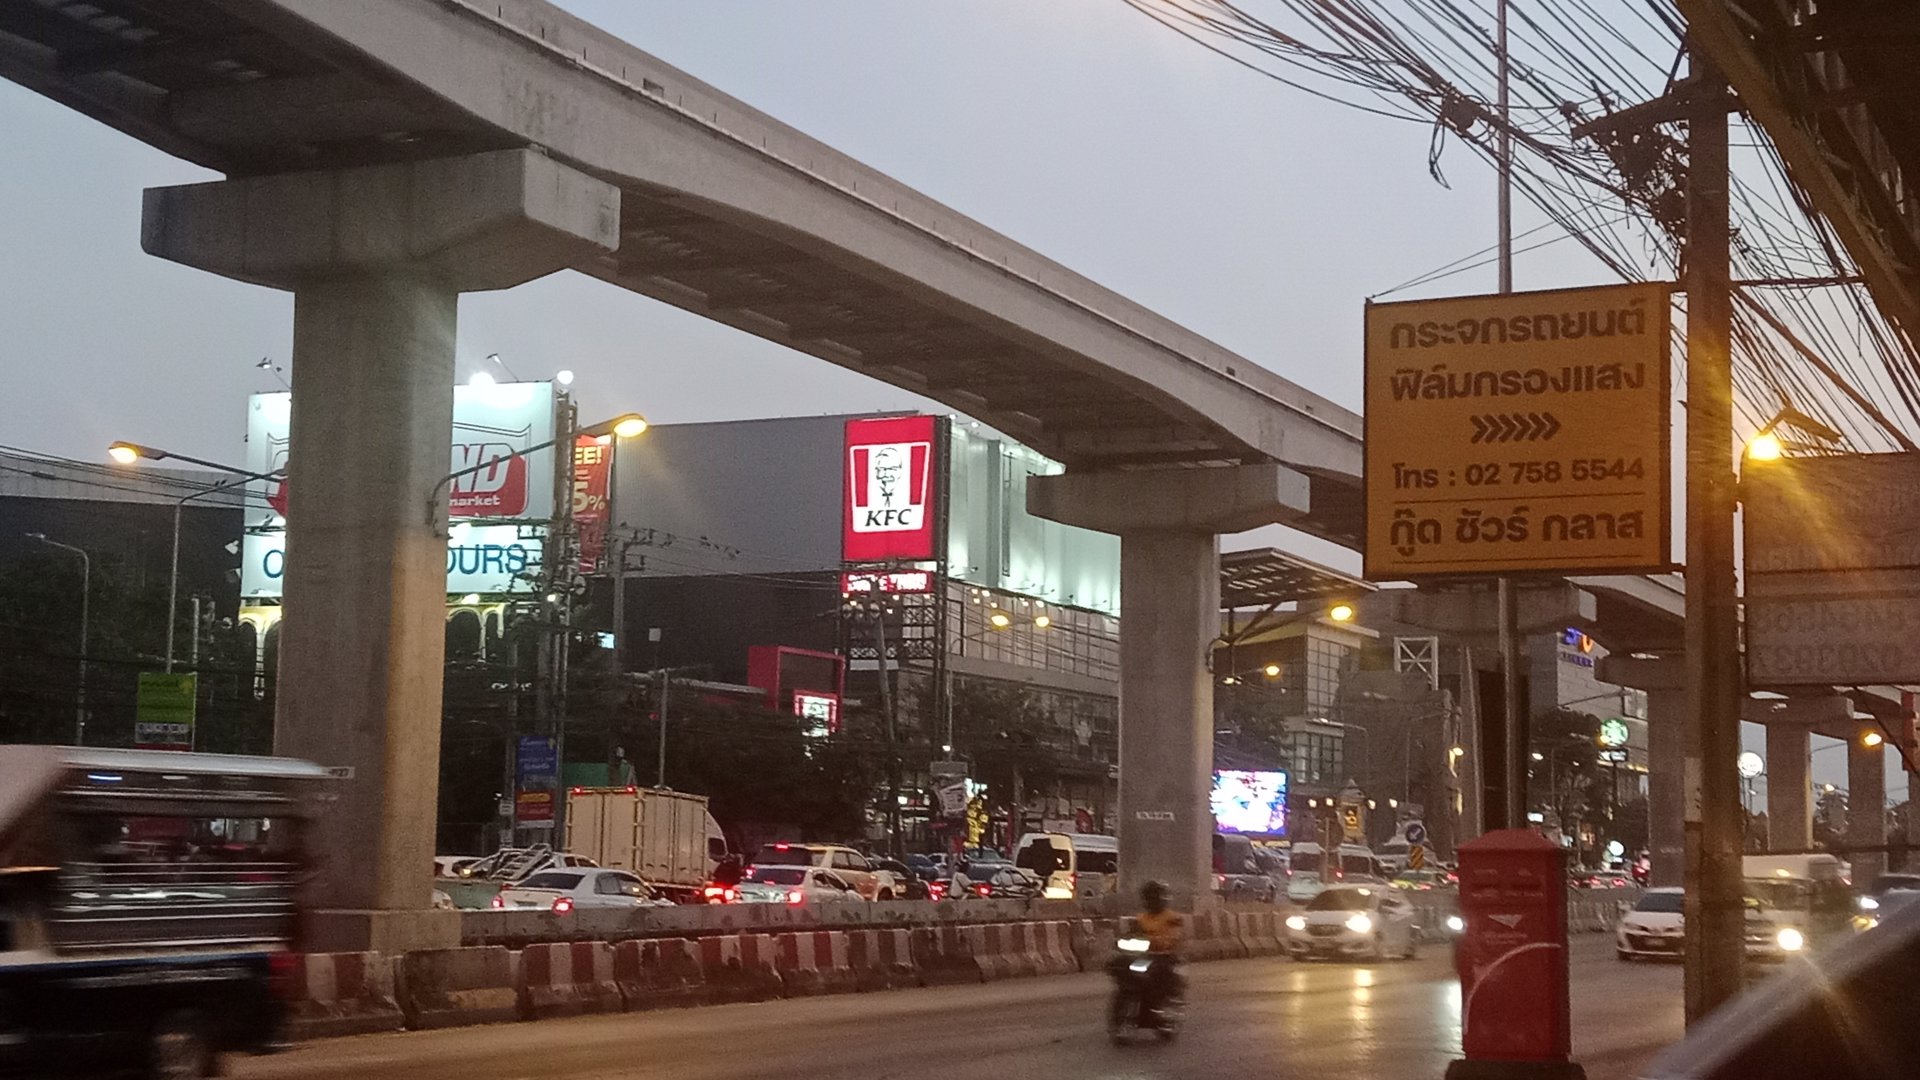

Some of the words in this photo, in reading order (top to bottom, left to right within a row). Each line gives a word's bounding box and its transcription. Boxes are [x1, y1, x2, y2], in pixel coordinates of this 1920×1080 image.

[1390, 297, 1647, 349] กระจกรถยนต์
[1390, 362, 1646, 401] ฟิล์มกรองแสง
[450, 442, 515, 493] ND
[574, 445, 602, 465] EE!
[1392, 462, 1439, 489] โทร
[1464, 463, 1500, 486] 02
[1508, 461, 1562, 484] 758
[1571, 457, 1645, 481] 5544
[449, 494, 501, 506] market
[573, 481, 606, 513] 5%
[865, 508, 911, 527] KFC
[1542, 510, 1644, 542] กลาส
